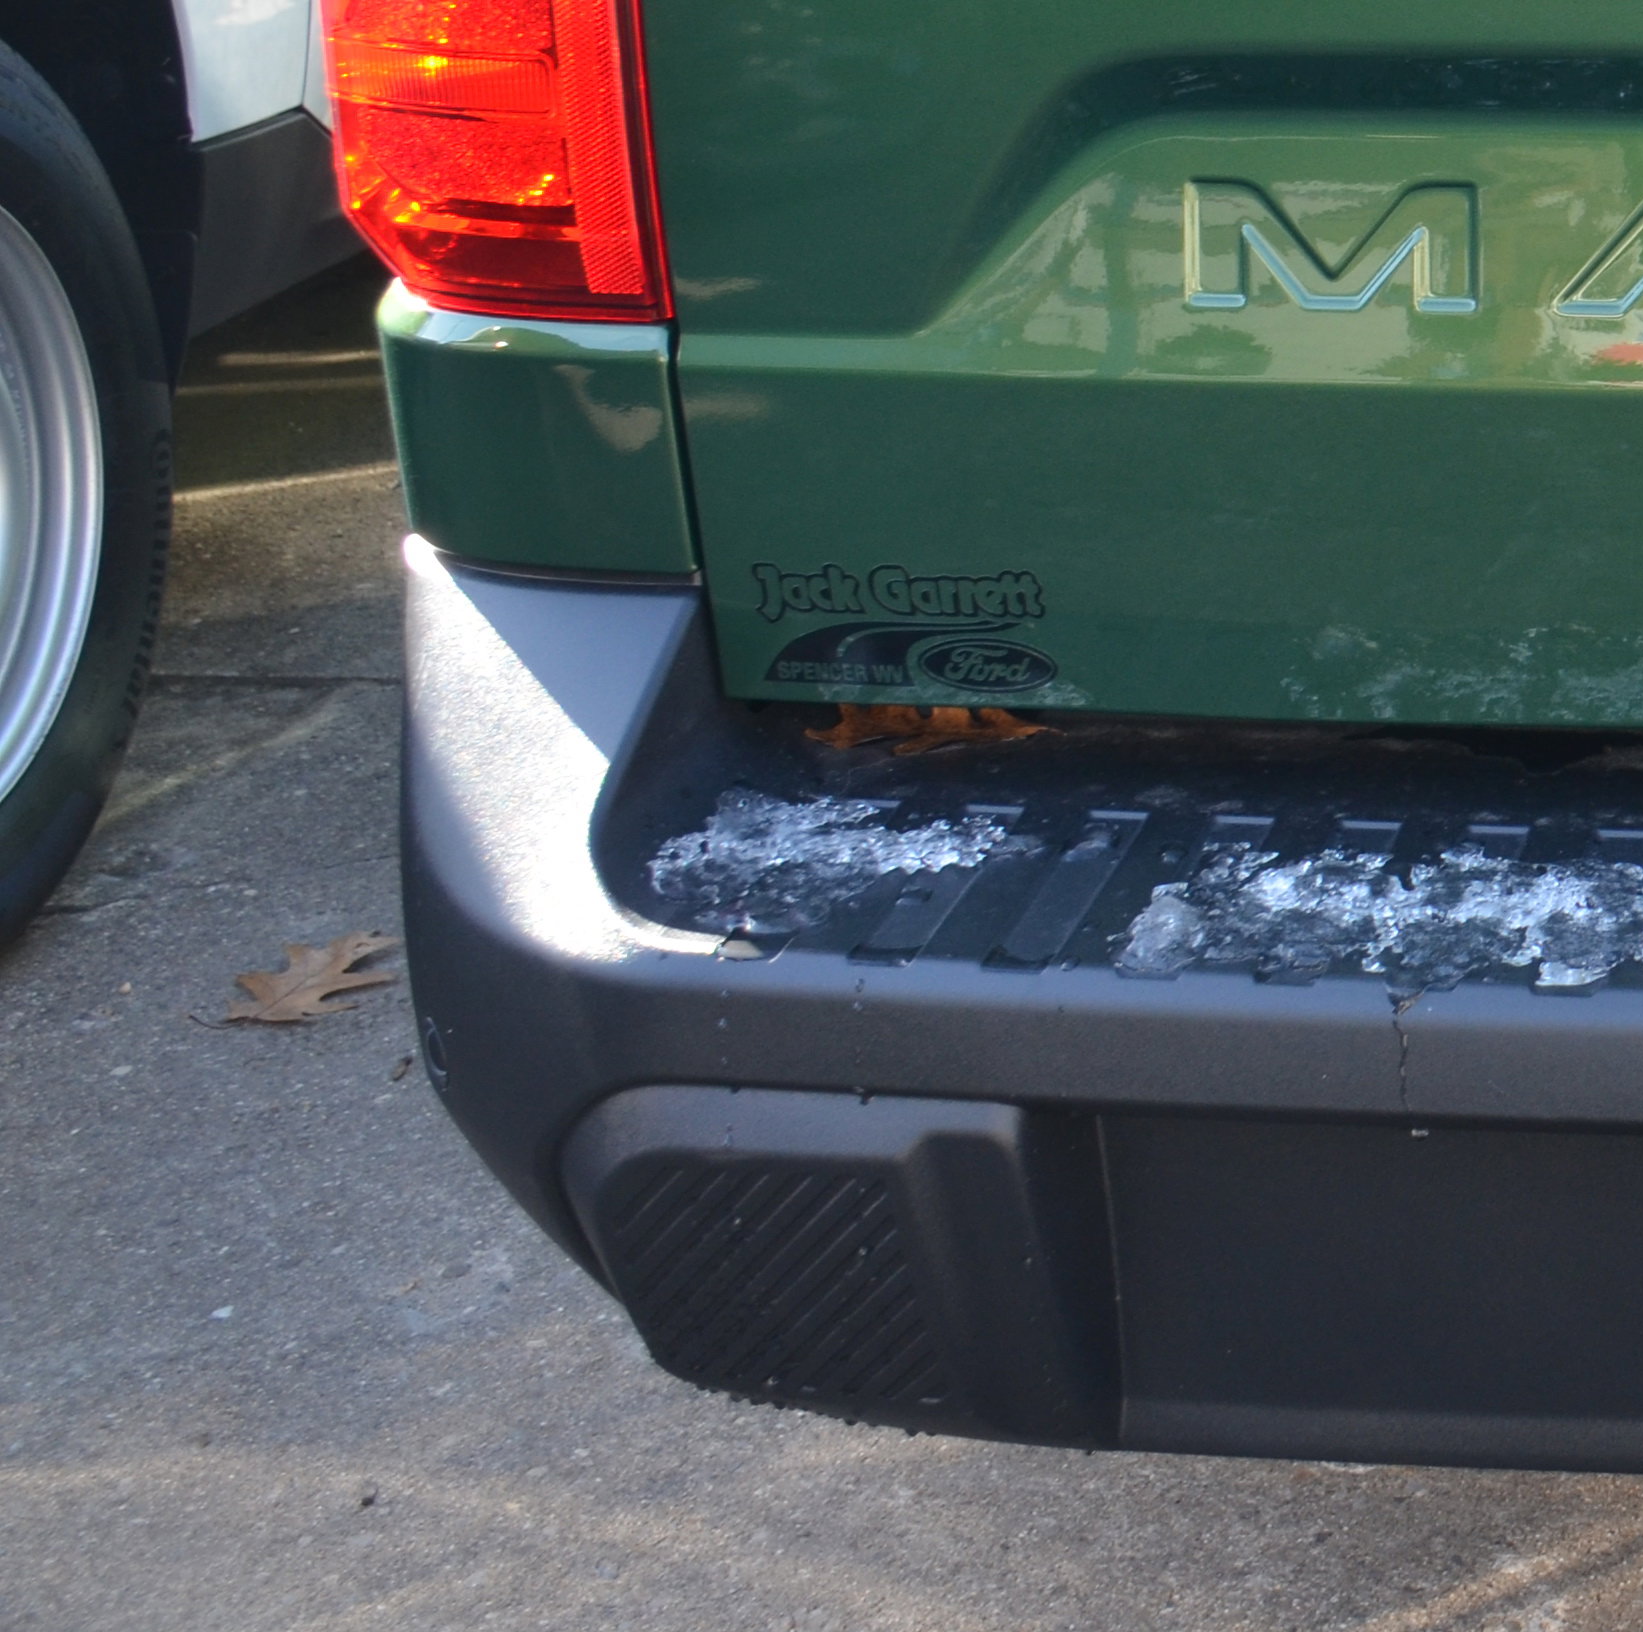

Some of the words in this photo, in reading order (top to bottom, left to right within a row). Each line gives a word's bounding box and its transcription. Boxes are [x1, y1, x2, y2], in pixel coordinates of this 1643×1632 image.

[752, 561, 866, 623] Jack
[868, 563, 1047, 618] Garrett
[776, 661, 868, 683] SPENCER
[943, 645, 1032, 683] Ford
